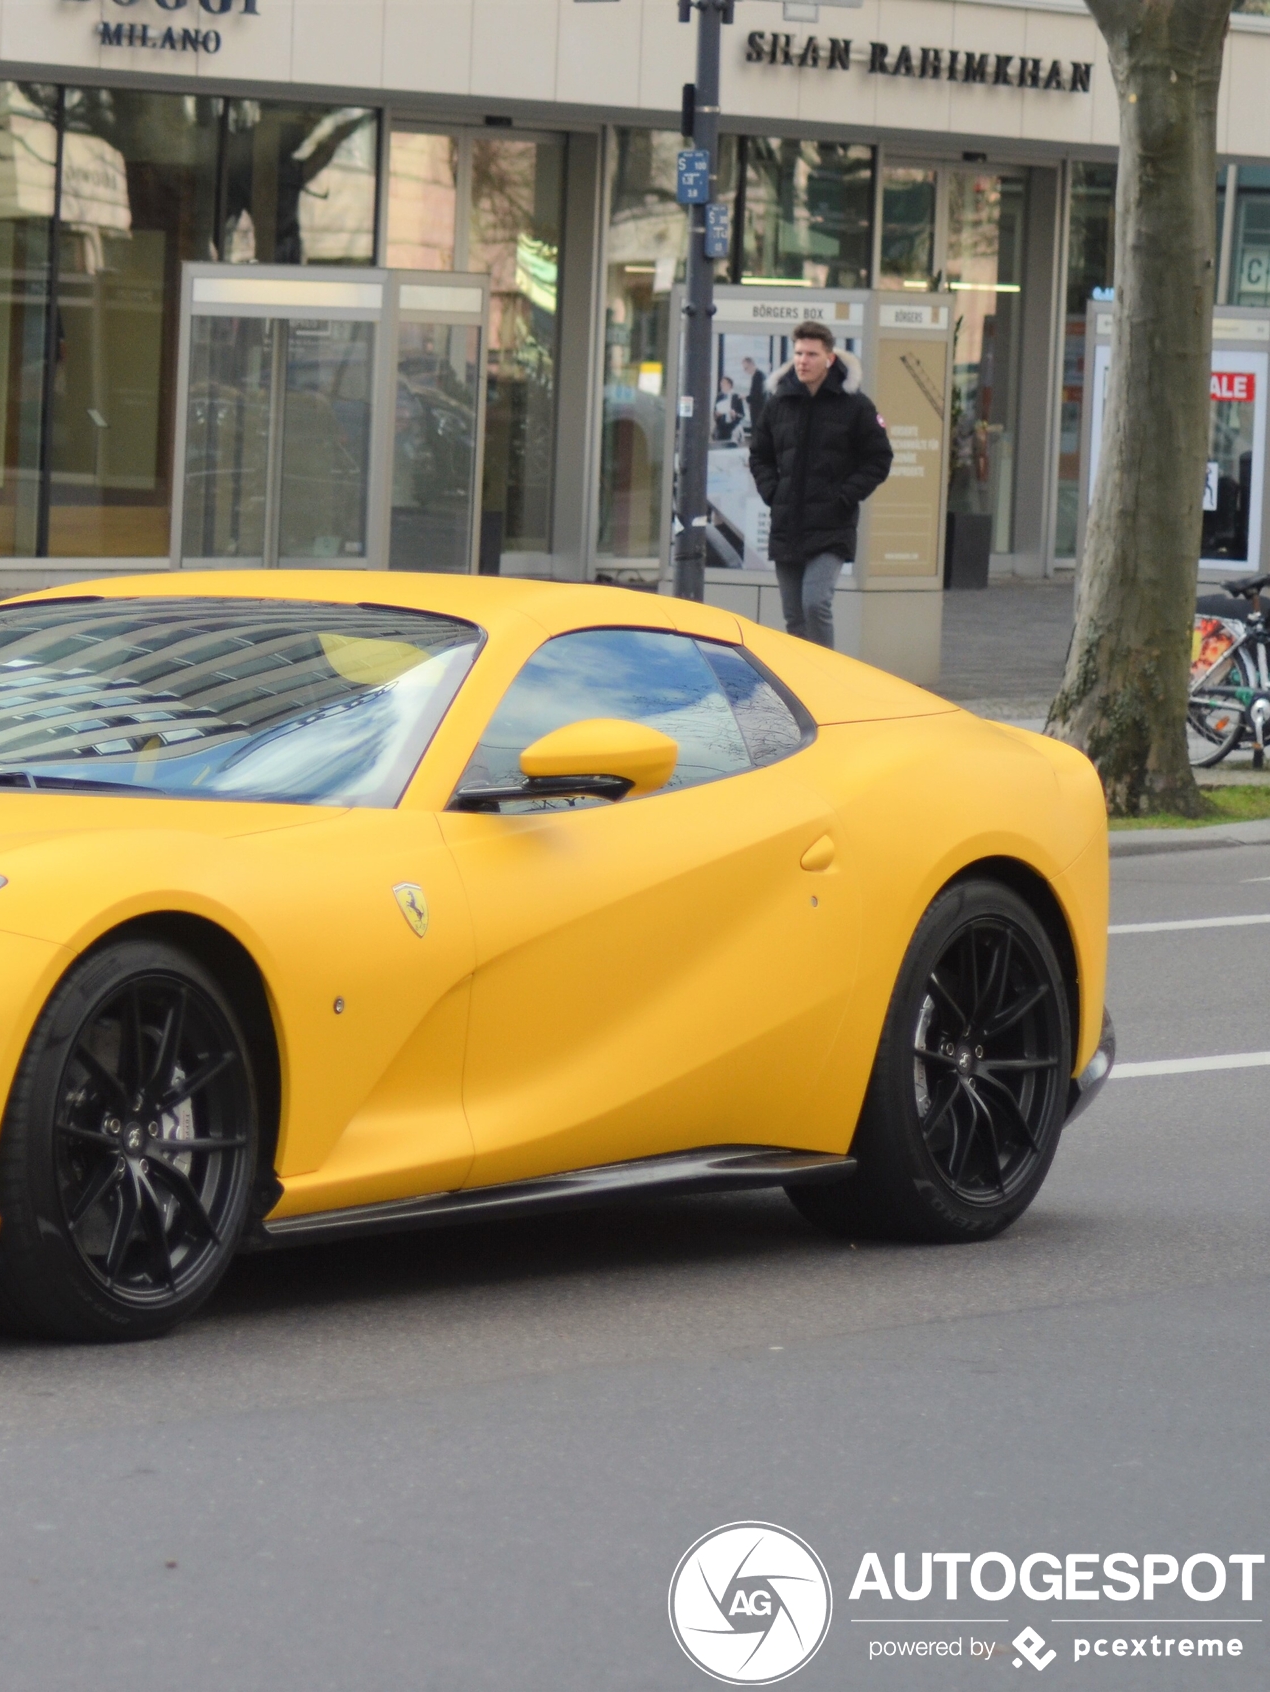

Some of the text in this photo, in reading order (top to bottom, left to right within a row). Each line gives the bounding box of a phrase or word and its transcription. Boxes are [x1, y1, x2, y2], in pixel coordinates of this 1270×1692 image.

[100, 21, 221, 54] MILANO
[746, 31, 1093, 93] SHAN RAHIMKHAN
[752, 304, 824, 319] BÖRGERS BOX
[1211, 374, 1248, 398] ALE
